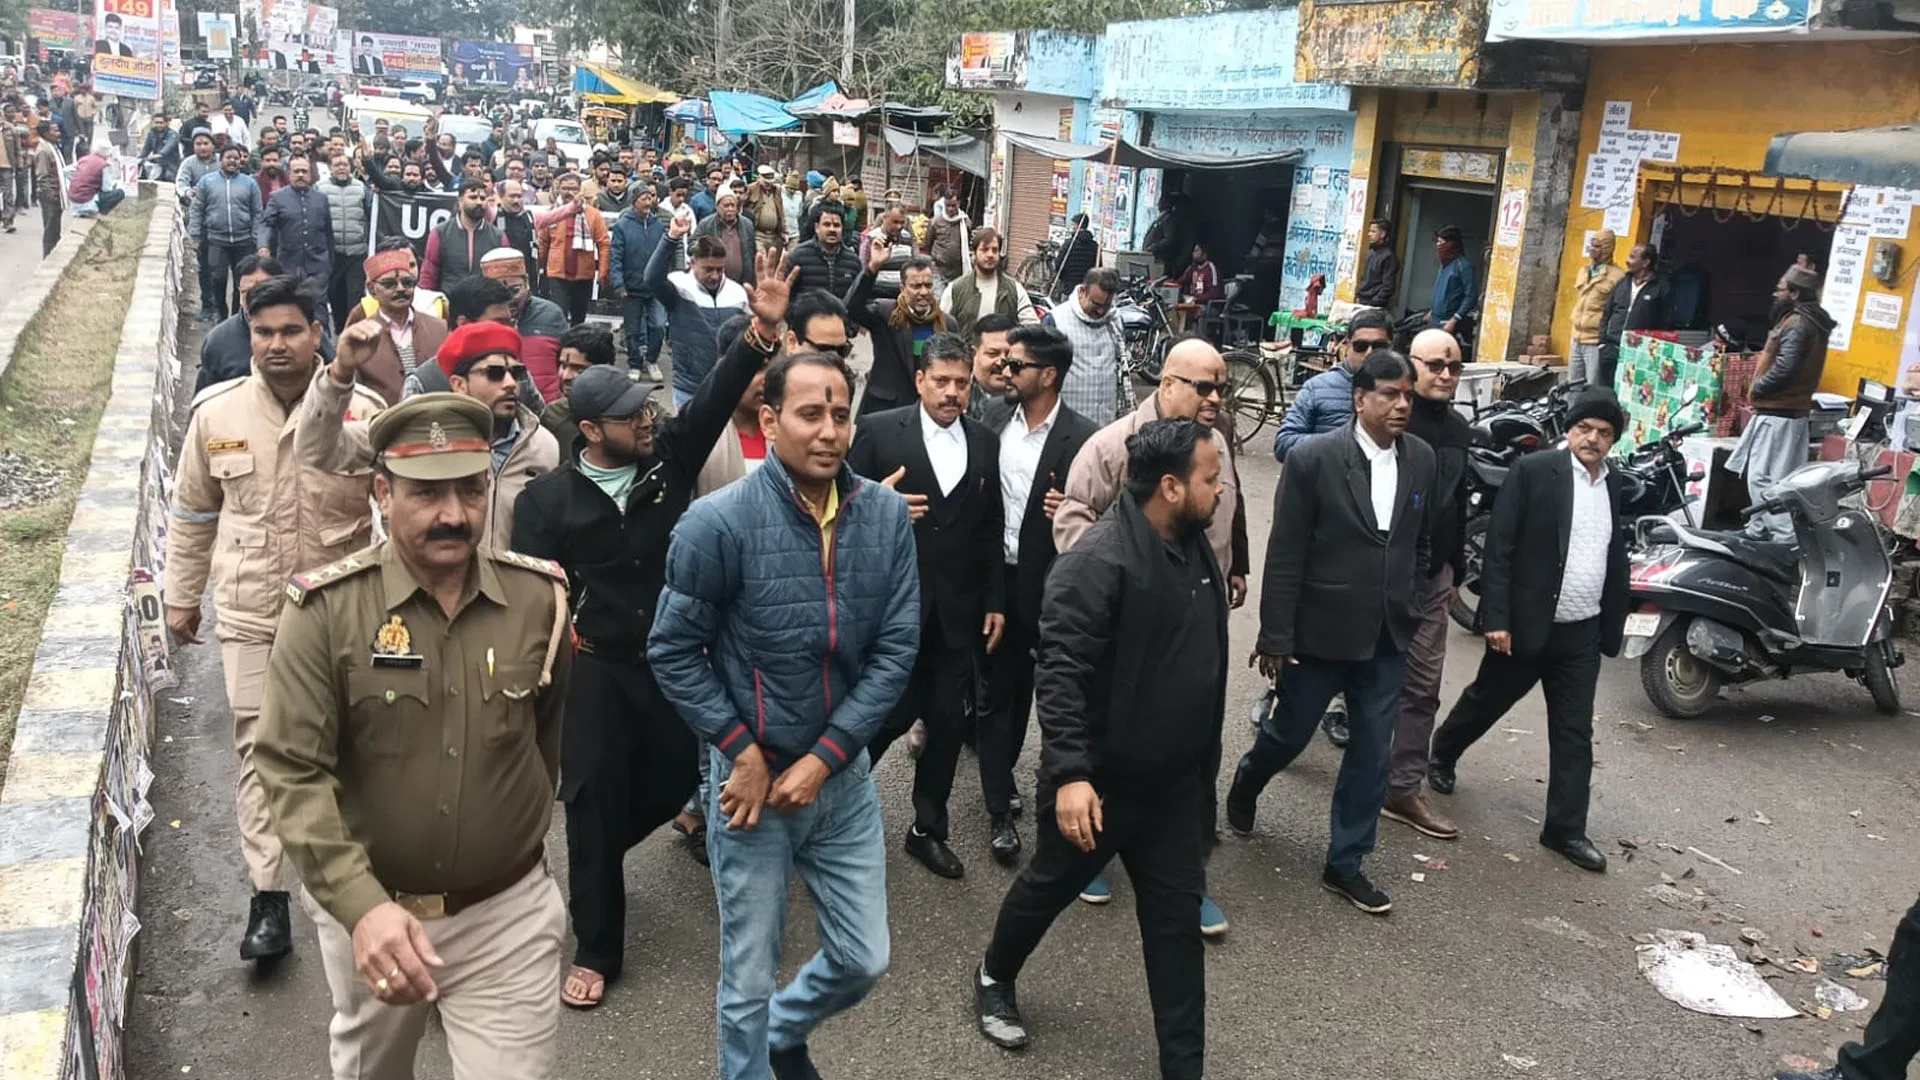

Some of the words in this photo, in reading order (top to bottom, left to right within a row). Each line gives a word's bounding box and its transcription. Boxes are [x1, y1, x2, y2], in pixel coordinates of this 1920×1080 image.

[105, 0, 149, 16] 149
[121, 163, 138, 183] 12
[1350, 190, 1365, 213] 12
[1503, 200, 1522, 227] 12
[138, 594, 160, 621] 0
